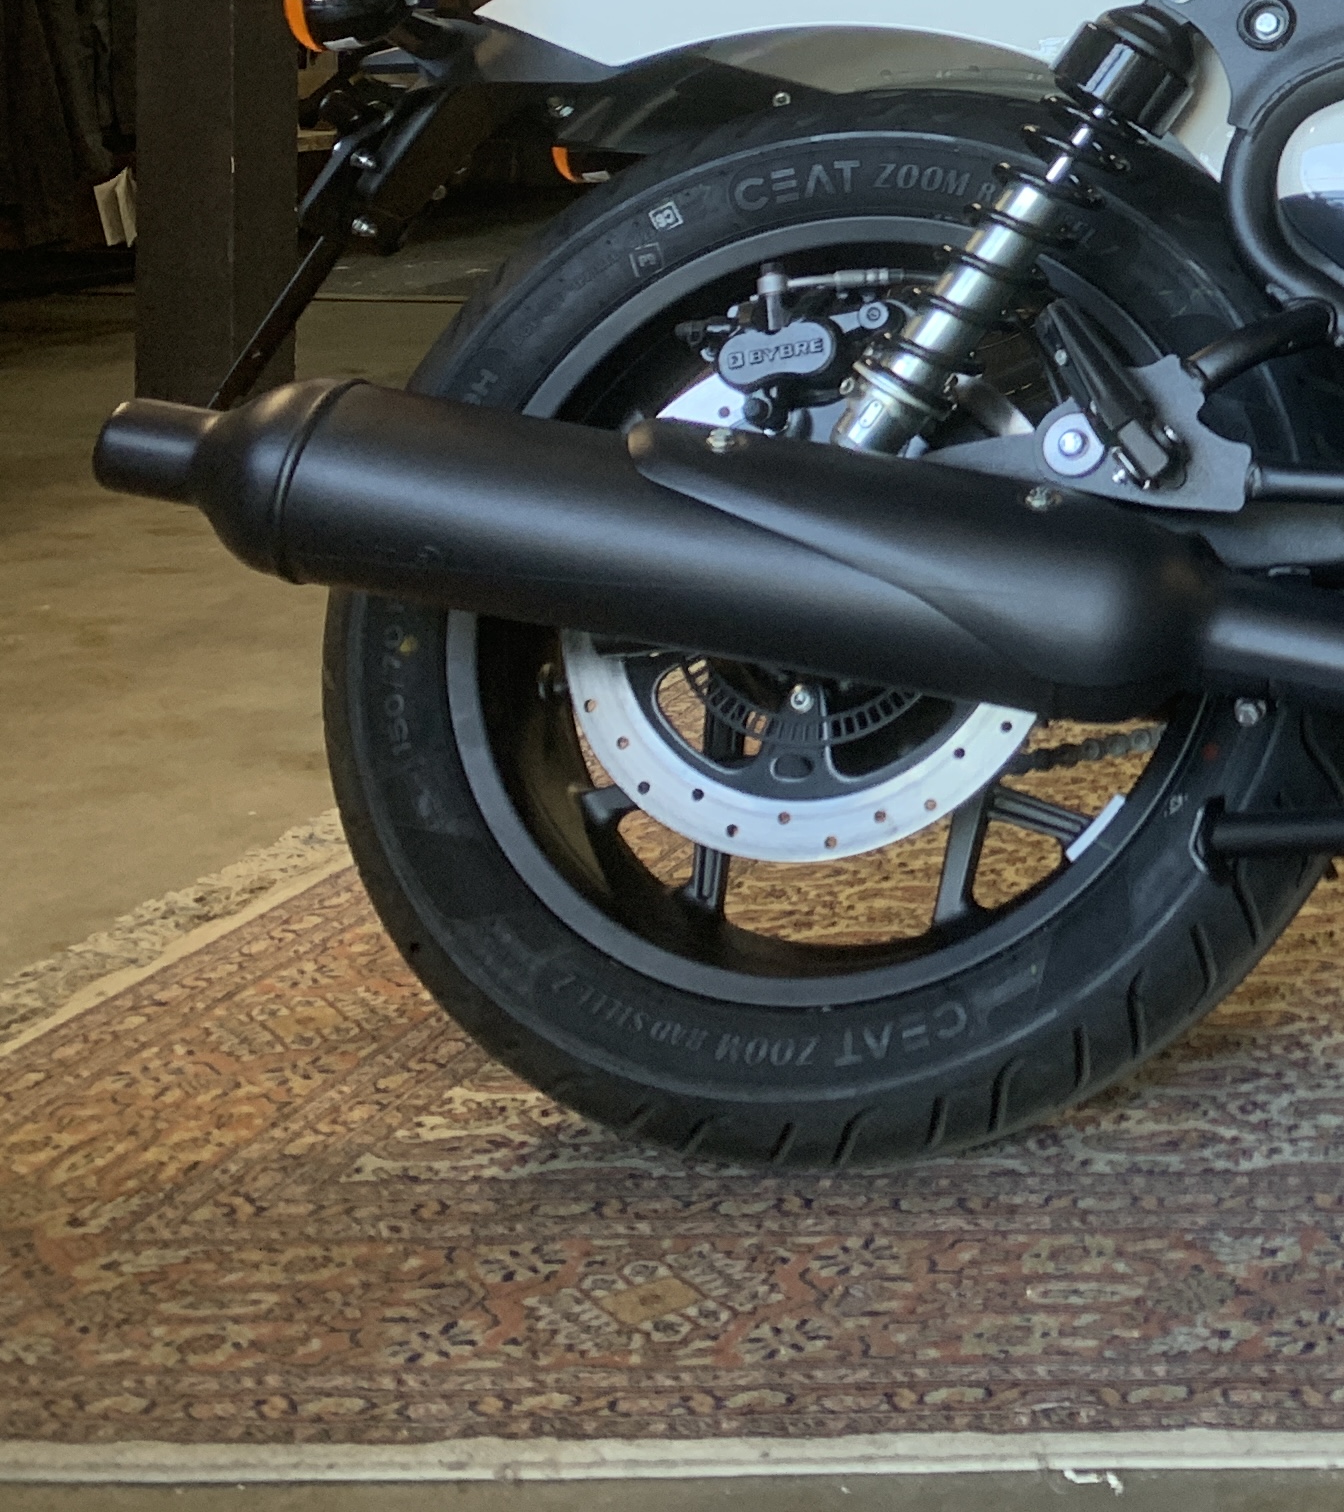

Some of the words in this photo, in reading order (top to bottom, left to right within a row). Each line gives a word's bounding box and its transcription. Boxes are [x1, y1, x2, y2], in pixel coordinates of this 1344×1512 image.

[733, 159, 861, 212] CEAT
[873, 163, 972, 197] ZOOM
[748, 336, 826, 367] BYBRE
[834, 1001, 970, 1069] CEAT
